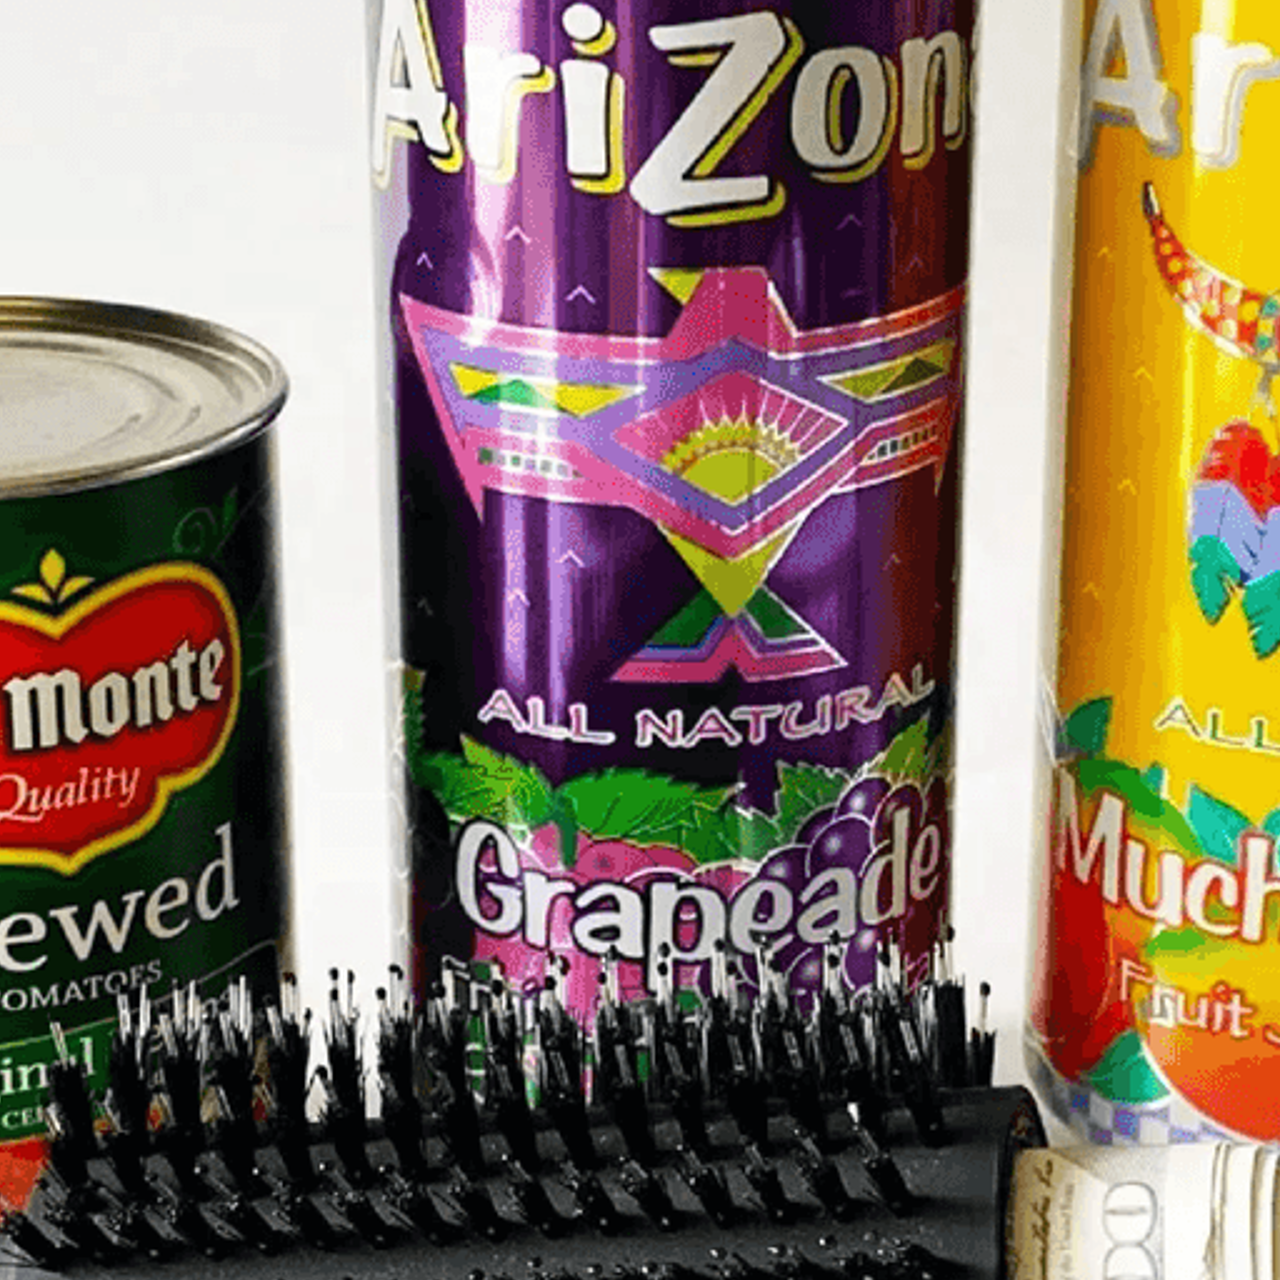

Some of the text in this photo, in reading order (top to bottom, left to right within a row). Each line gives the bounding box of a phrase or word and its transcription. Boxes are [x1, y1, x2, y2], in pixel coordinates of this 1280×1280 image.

[2, 636, 225, 750] Monte
[477, 663, 937, 749] ALL NATURAL
[455, 805, 942, 990] Grapeade
[1116, 956, 1255, 1041] Fruit
